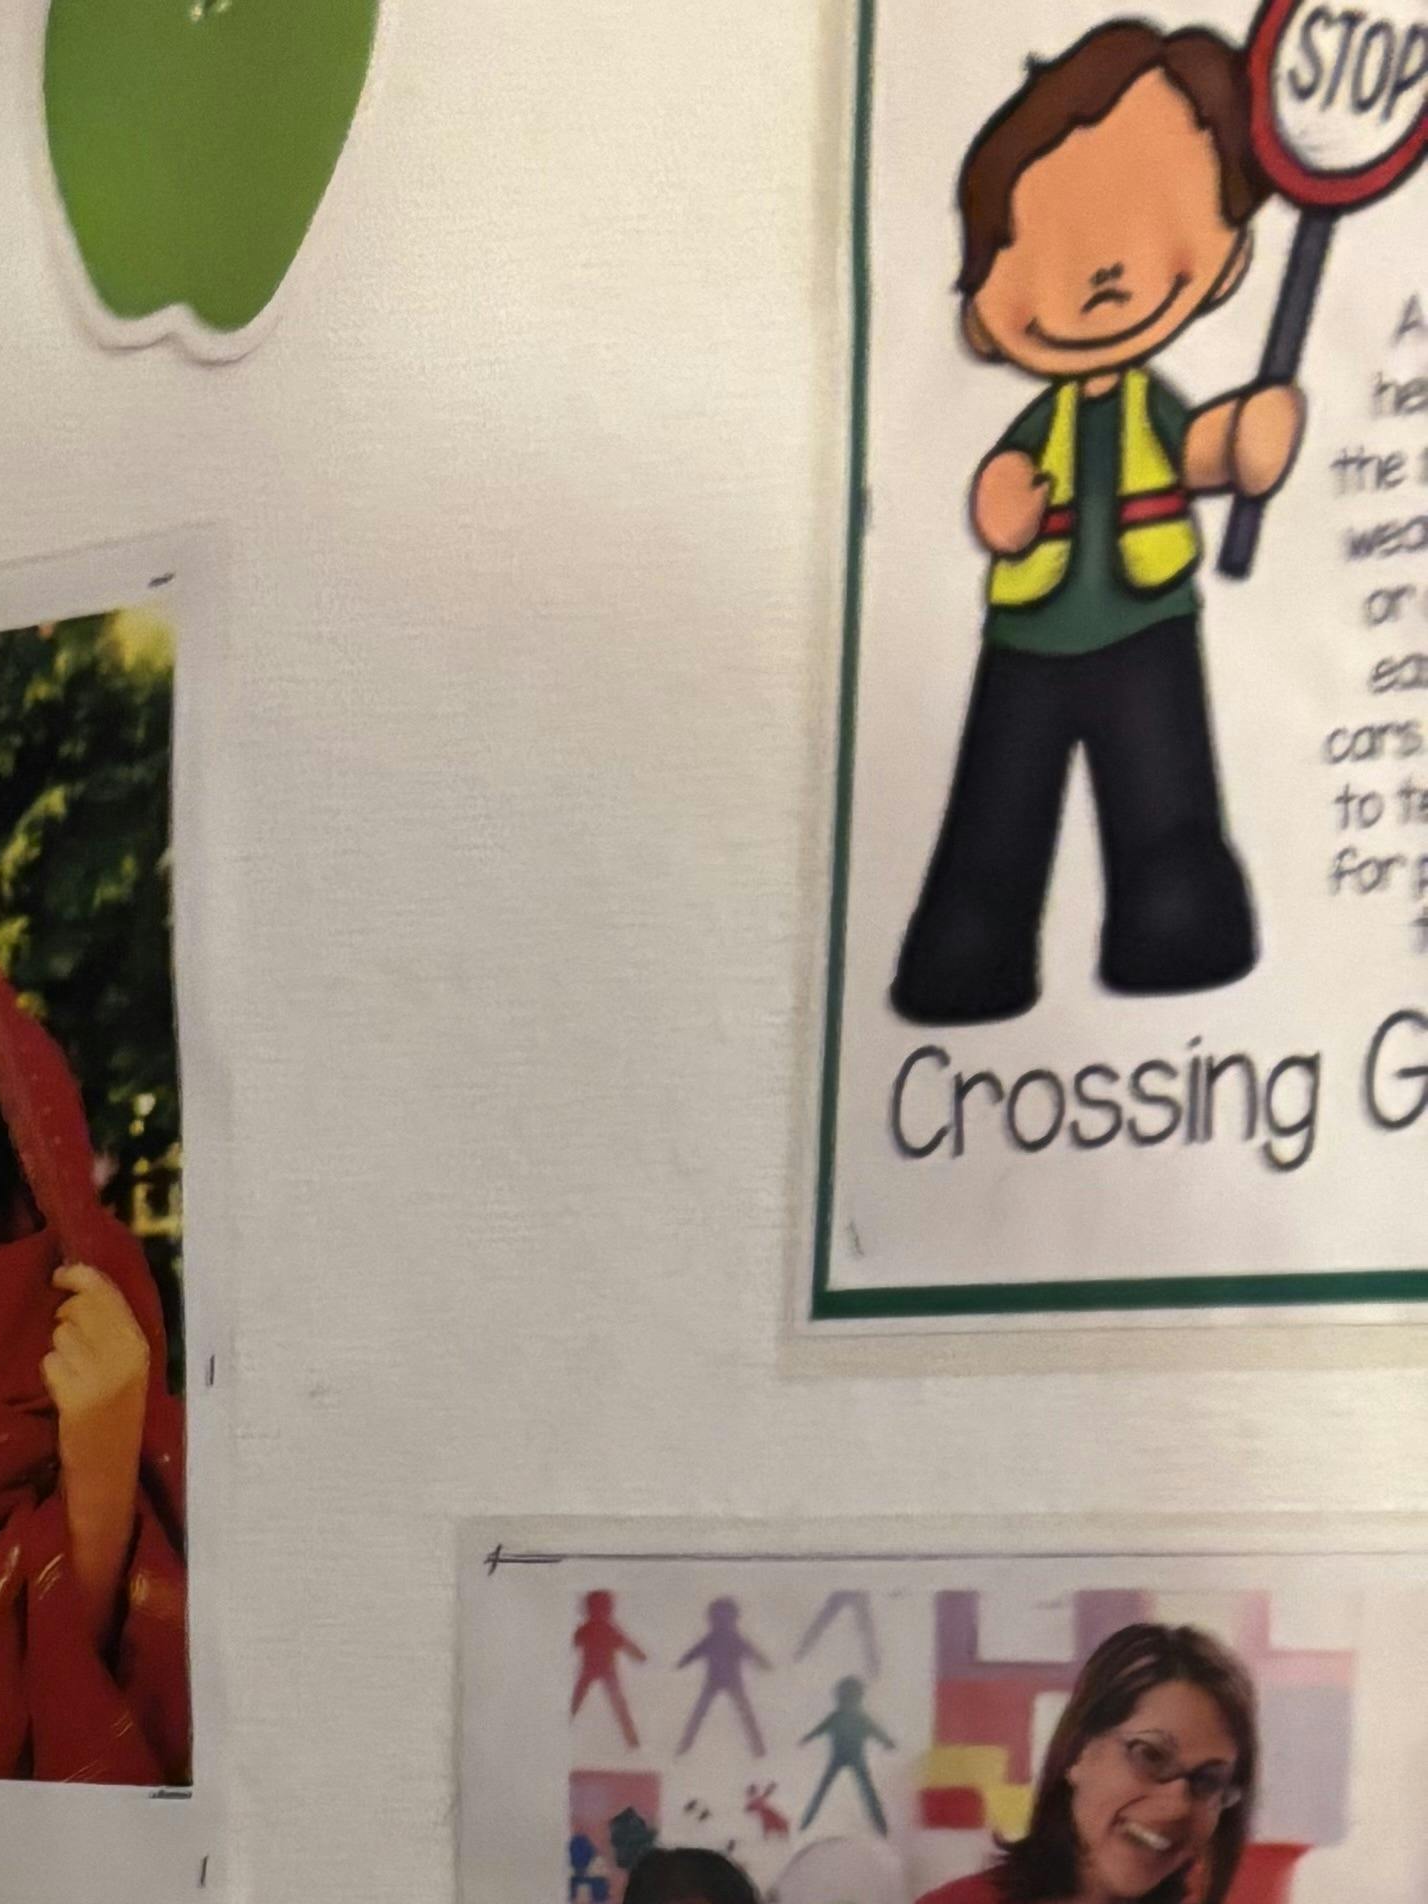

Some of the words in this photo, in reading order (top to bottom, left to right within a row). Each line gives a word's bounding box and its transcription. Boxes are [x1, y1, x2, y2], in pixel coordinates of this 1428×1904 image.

[1287, 5, 1428, 126] STOP
[1331, 446, 1407, 496] the
[1326, 719, 1425, 765] cars
[1334, 782, 1384, 829] to
[1331, 846, 1405, 894] for
[890, 1035, 1320, 1171] Crossing
